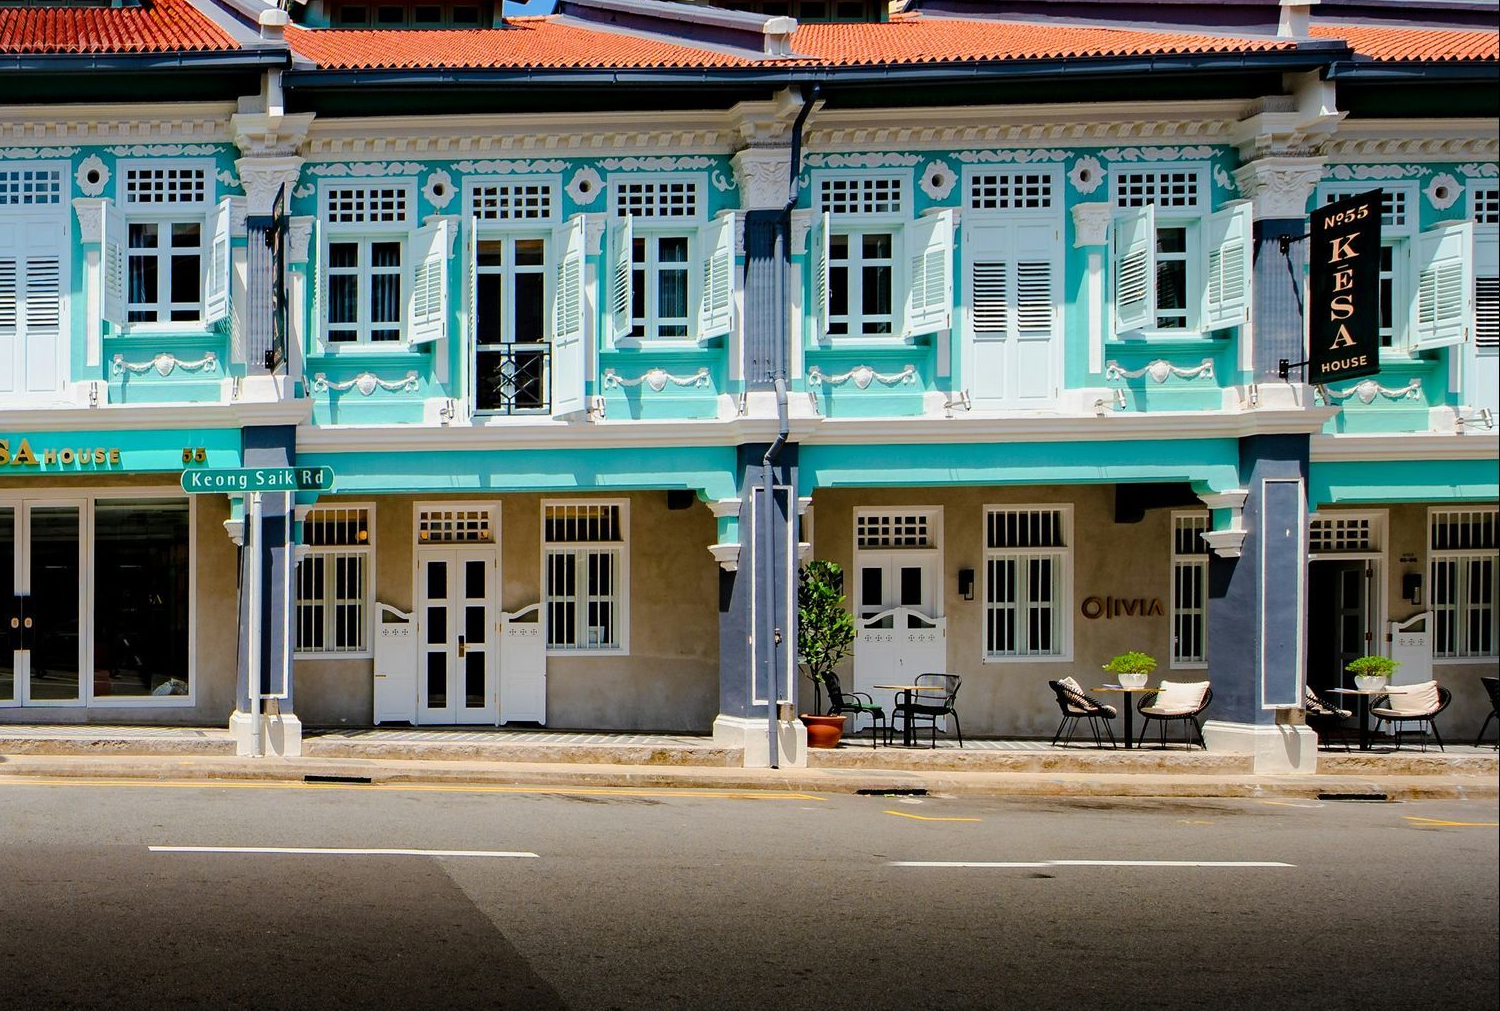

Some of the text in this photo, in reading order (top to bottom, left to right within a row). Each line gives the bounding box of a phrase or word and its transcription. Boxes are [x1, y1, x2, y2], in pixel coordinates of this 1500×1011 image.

[1321, 355, 1368, 373] HOUSE
[43, 447, 121, 465] HOUSE
[182, 447, 207, 463] 55
[192, 469, 324, 489] Keong Saik Rd
